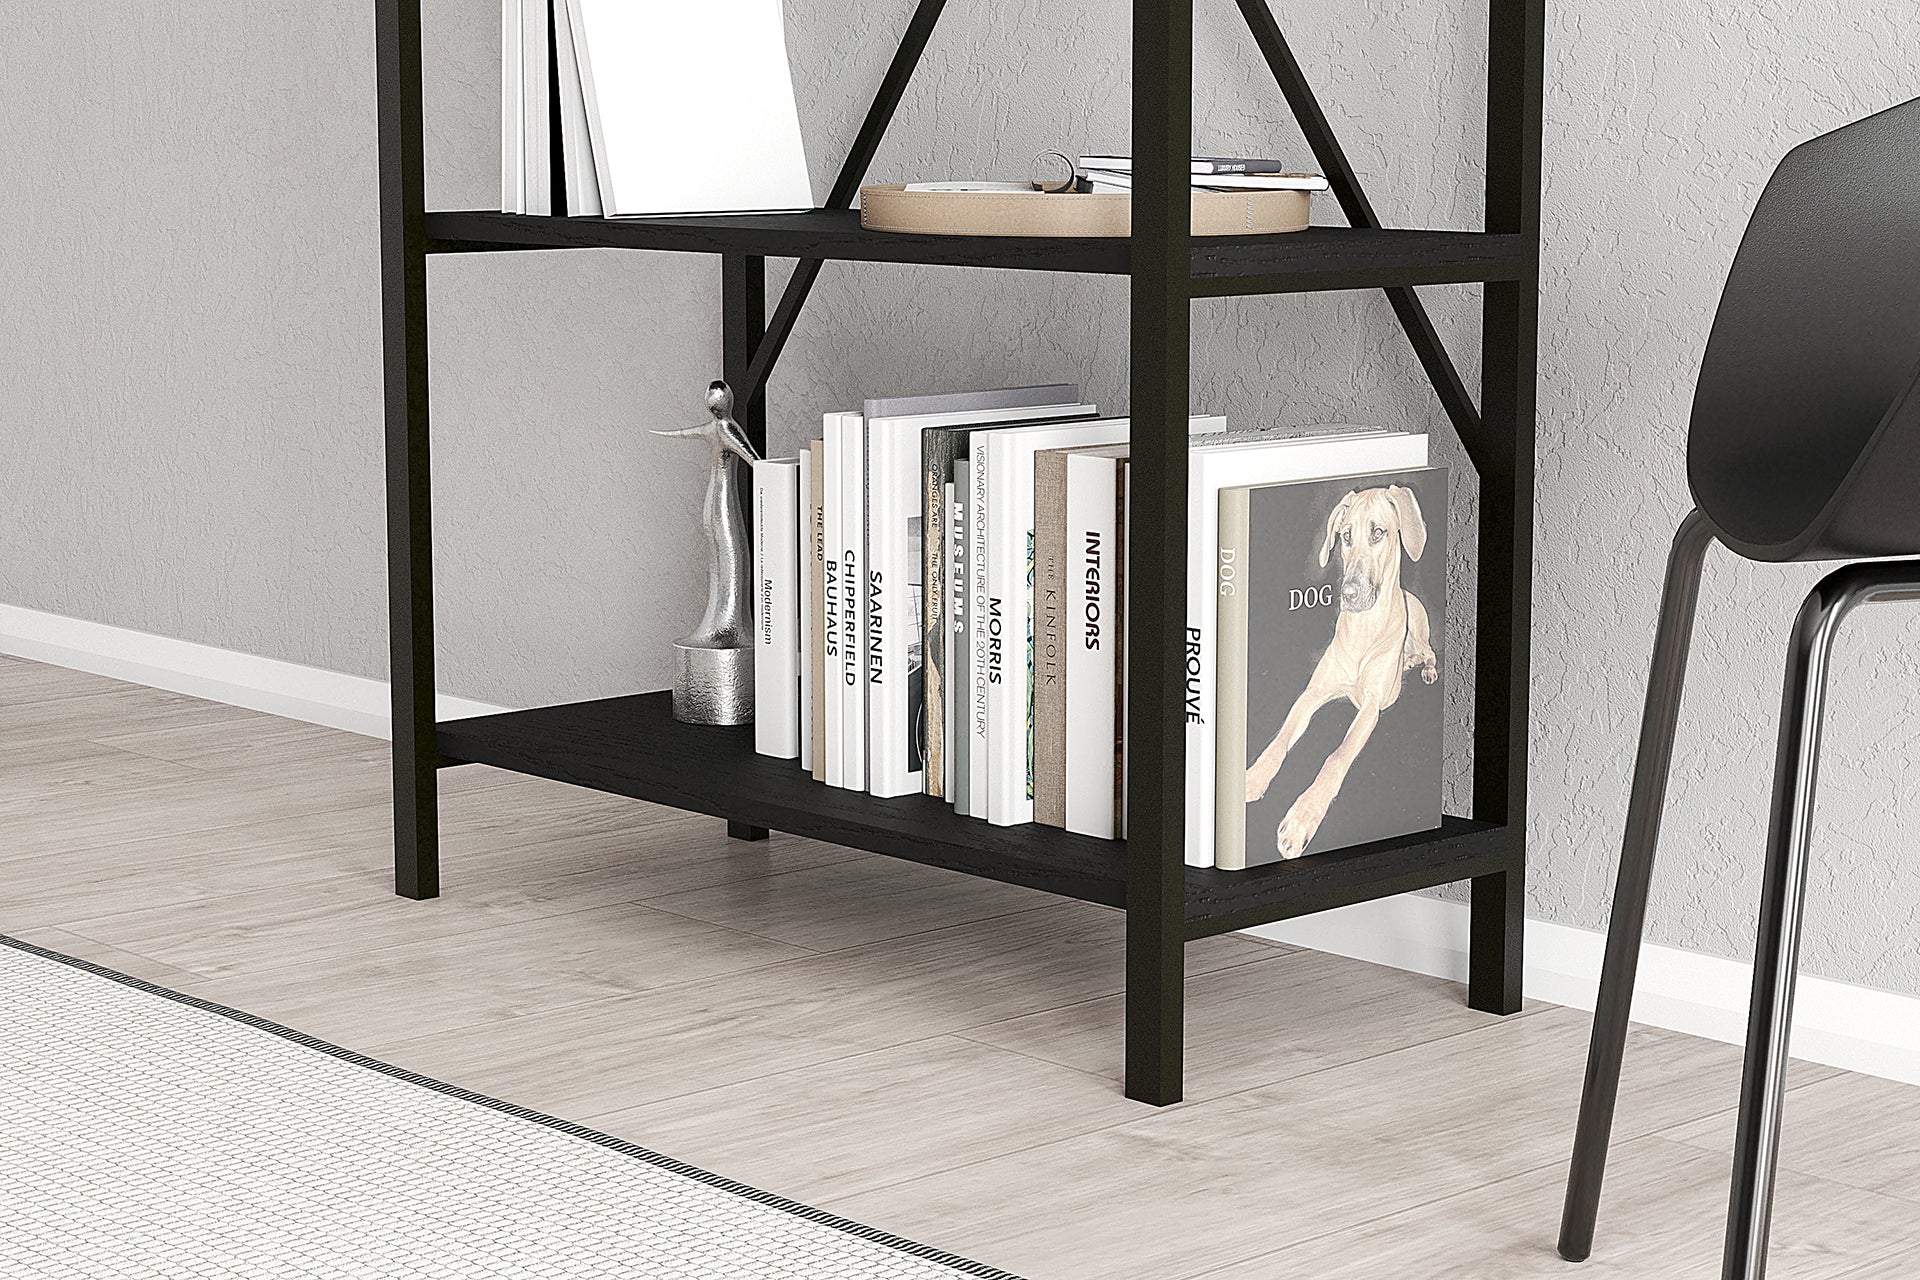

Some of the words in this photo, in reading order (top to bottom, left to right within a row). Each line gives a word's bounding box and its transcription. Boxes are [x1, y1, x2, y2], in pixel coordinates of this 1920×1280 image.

[931, 463, 939, 508] ORANGES
[976, 445, 985, 503] VISIONARY
[931, 553, 939, 568] THE
[953, 503, 964, 634] MUSEUMS
[976, 504, 986, 593] ARCHITECTURE
[1047, 555, 1055, 581] THE
[1219, 546, 1235, 597] DOG
[764, 579, 773, 645] Modernism
[826, 559, 838, 657] BAUHAUS
[931, 570, 939, 595] ONLY
[931, 597, 939, 622] FRUIT
[976, 595, 986, 613] OF
[1085, 530, 1101, 652] INTERIORS
[1288, 584, 1333, 611] DOG
[844, 549, 856, 686] CHIPPERFIELD
[869, 570, 883, 685] SAARINEN
[976, 614, 986, 638] THE
[988, 597, 1002, 685] MORRIS
[1045, 589, 1057, 686] KINFOLK
[976, 640, 986, 675] 20TH
[1185, 626, 1205, 726] PROUVÉ
[976, 677, 987, 739] CENTURY
